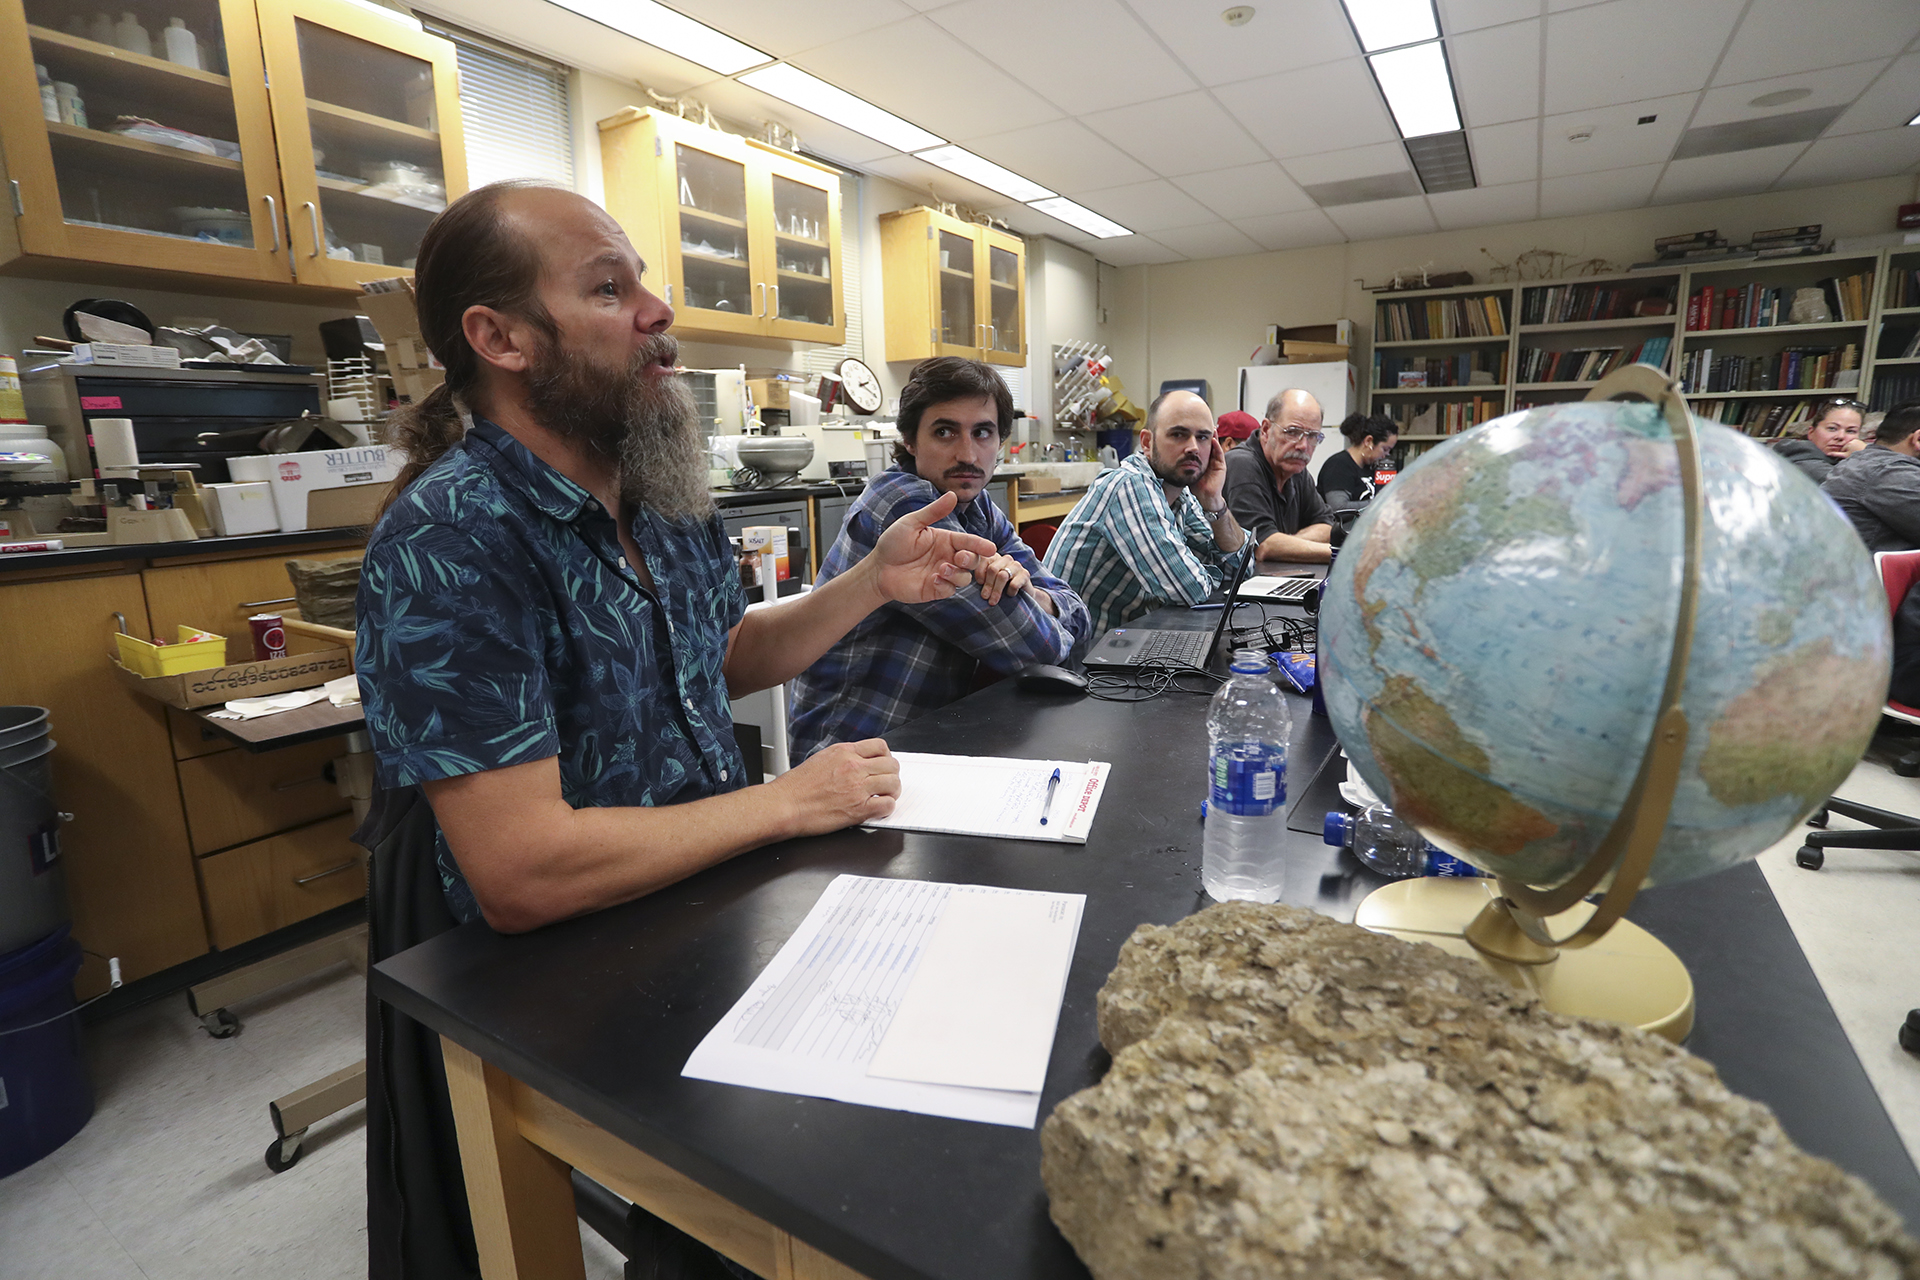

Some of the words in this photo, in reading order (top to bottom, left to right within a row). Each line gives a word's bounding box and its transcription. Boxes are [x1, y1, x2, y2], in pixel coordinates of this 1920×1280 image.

[324, 448, 386, 466] BUTTER
[270, 650, 286, 660] IZZE
[1078, 796, 1090, 812] DEPOT
